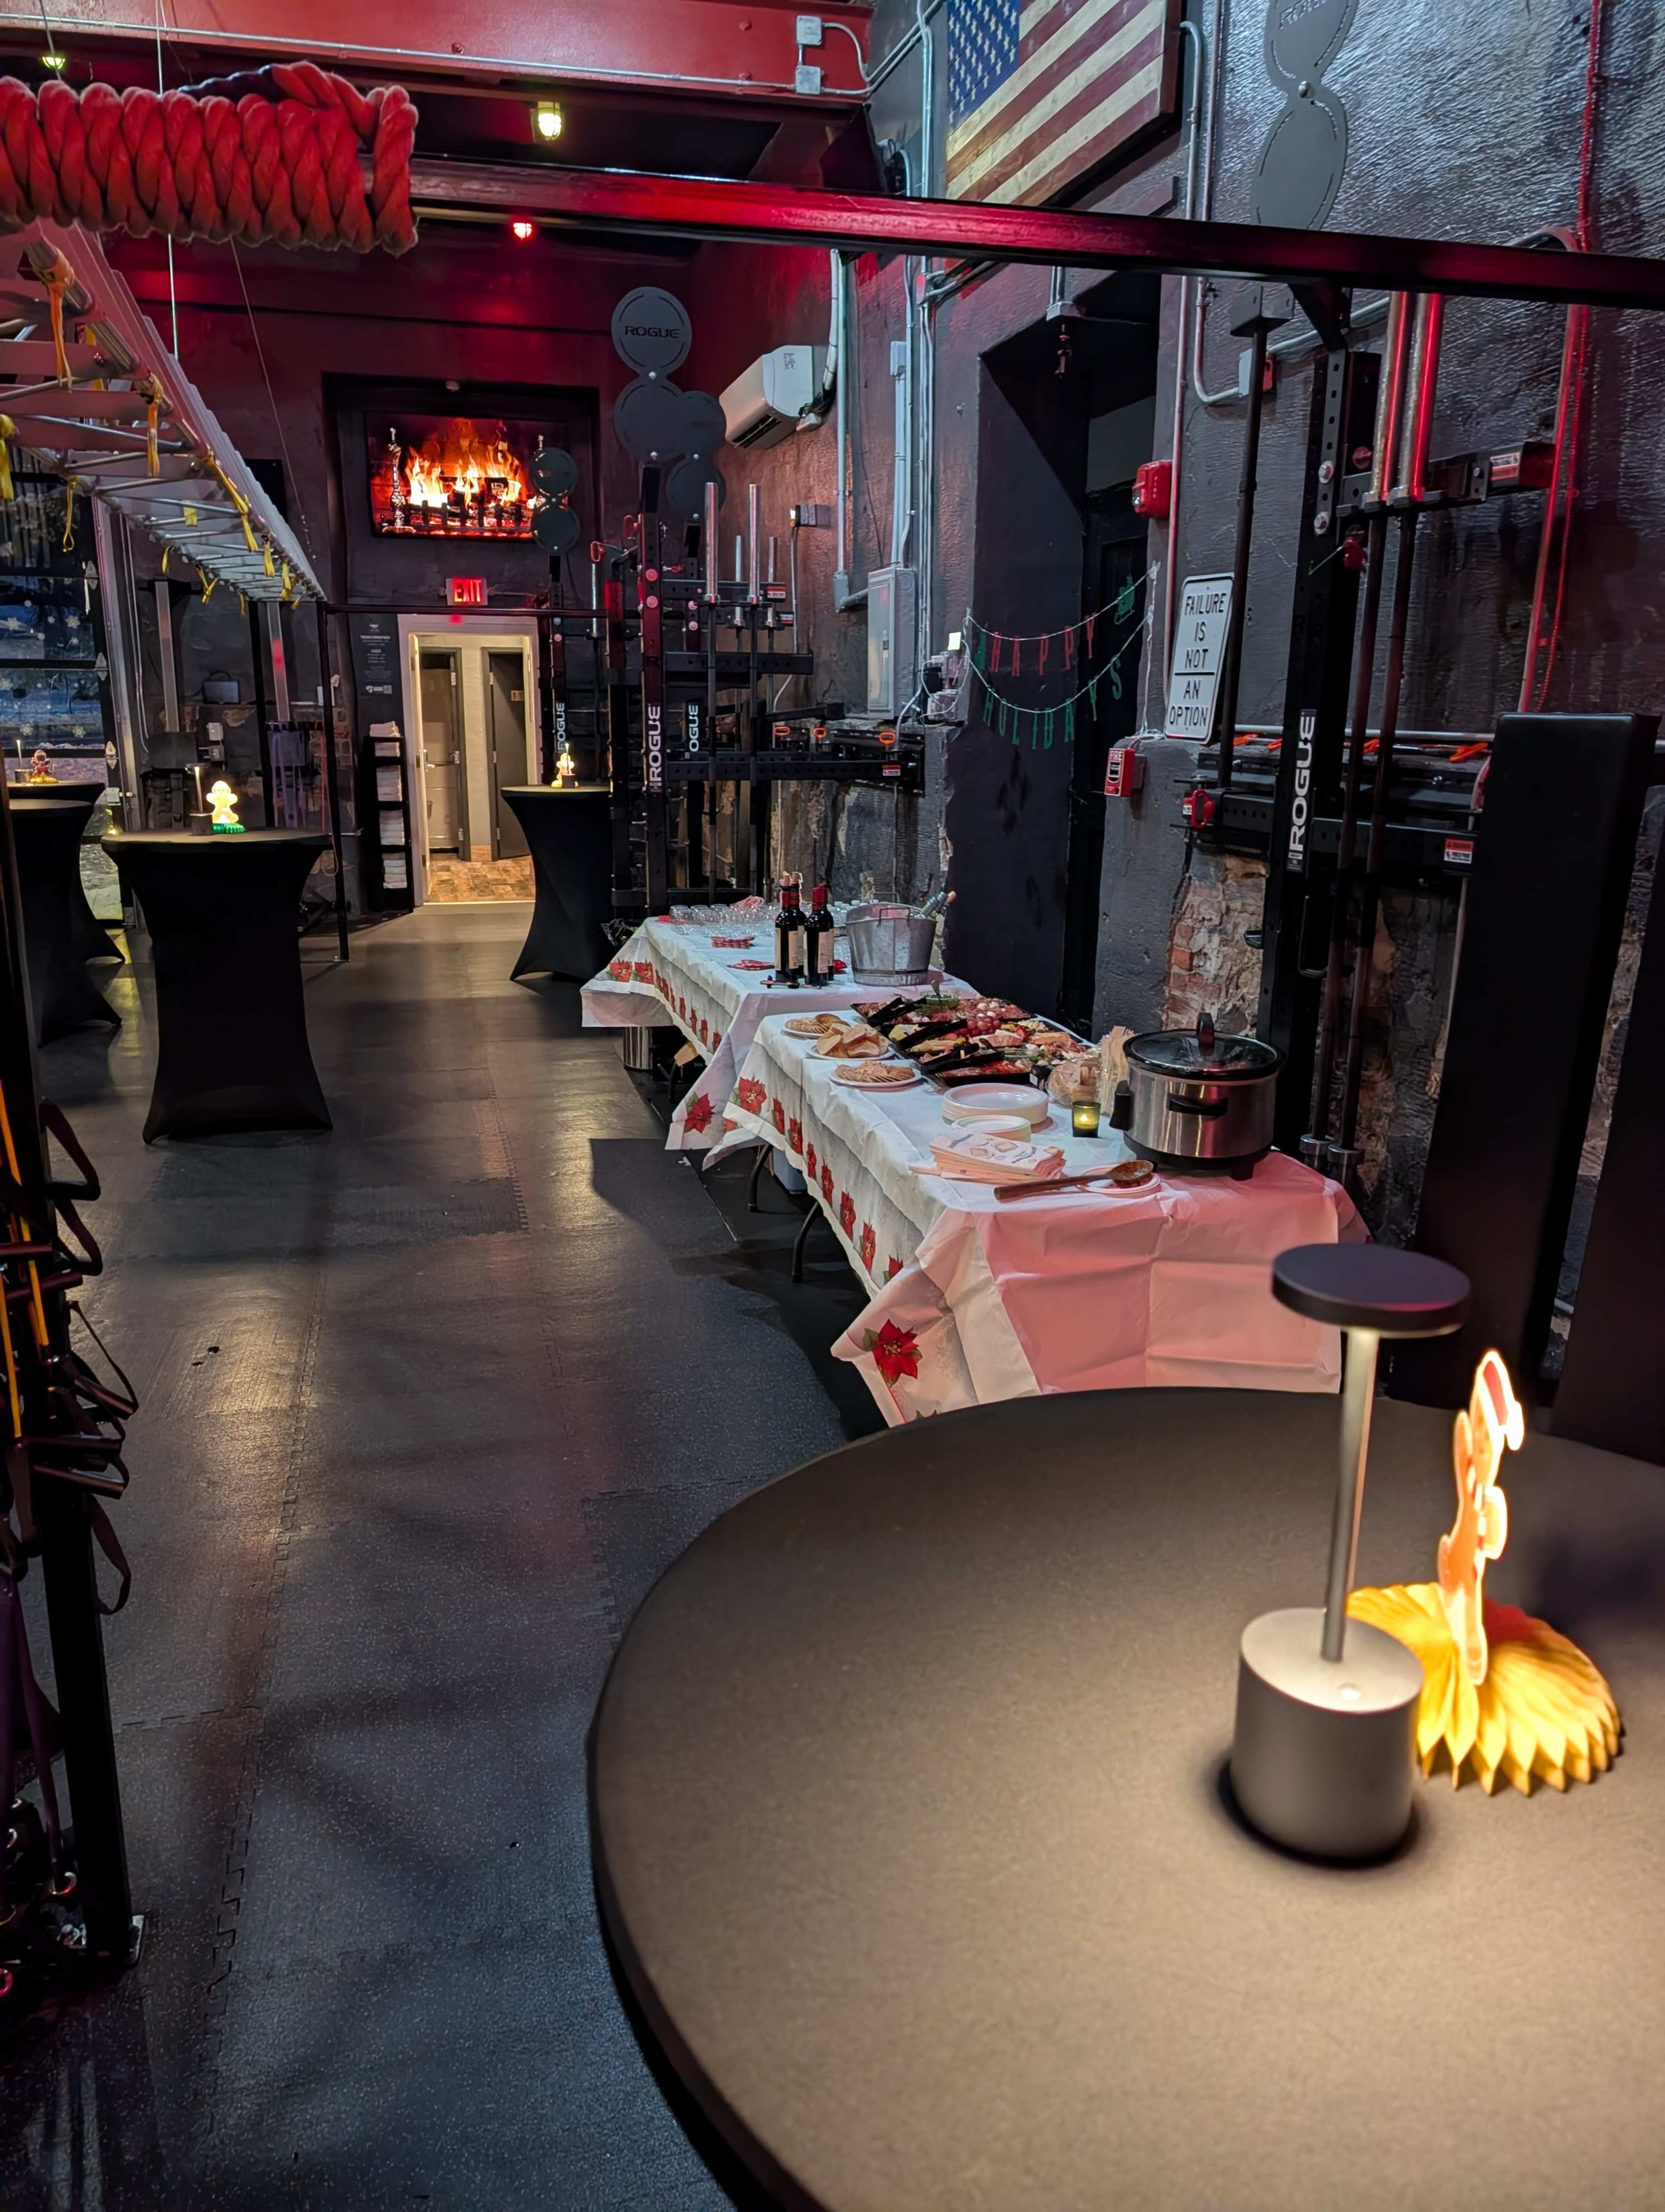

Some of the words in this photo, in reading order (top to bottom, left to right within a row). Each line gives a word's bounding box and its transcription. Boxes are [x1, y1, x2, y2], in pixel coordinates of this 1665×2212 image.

[625, 326, 679, 338] ROGUE
[454, 579, 481, 602] EXIT
[1184, 593, 1227, 616] FAILURE
[1194, 621, 1207, 642] IS
[990, 612, 1096, 676] HAPPY
[1184, 648, 1209, 669] NOT
[1183, 679, 1201, 699] AN
[982, 655, 1122, 749] HOLIDAYS
[1169, 706, 1208, 727] OPTION
[689, 705, 699, 752] OGUE
[648, 706, 662, 781] ROGUE
[1110, 751, 1123, 760] FIRE
[1290, 716, 1315, 851] ROGUE
